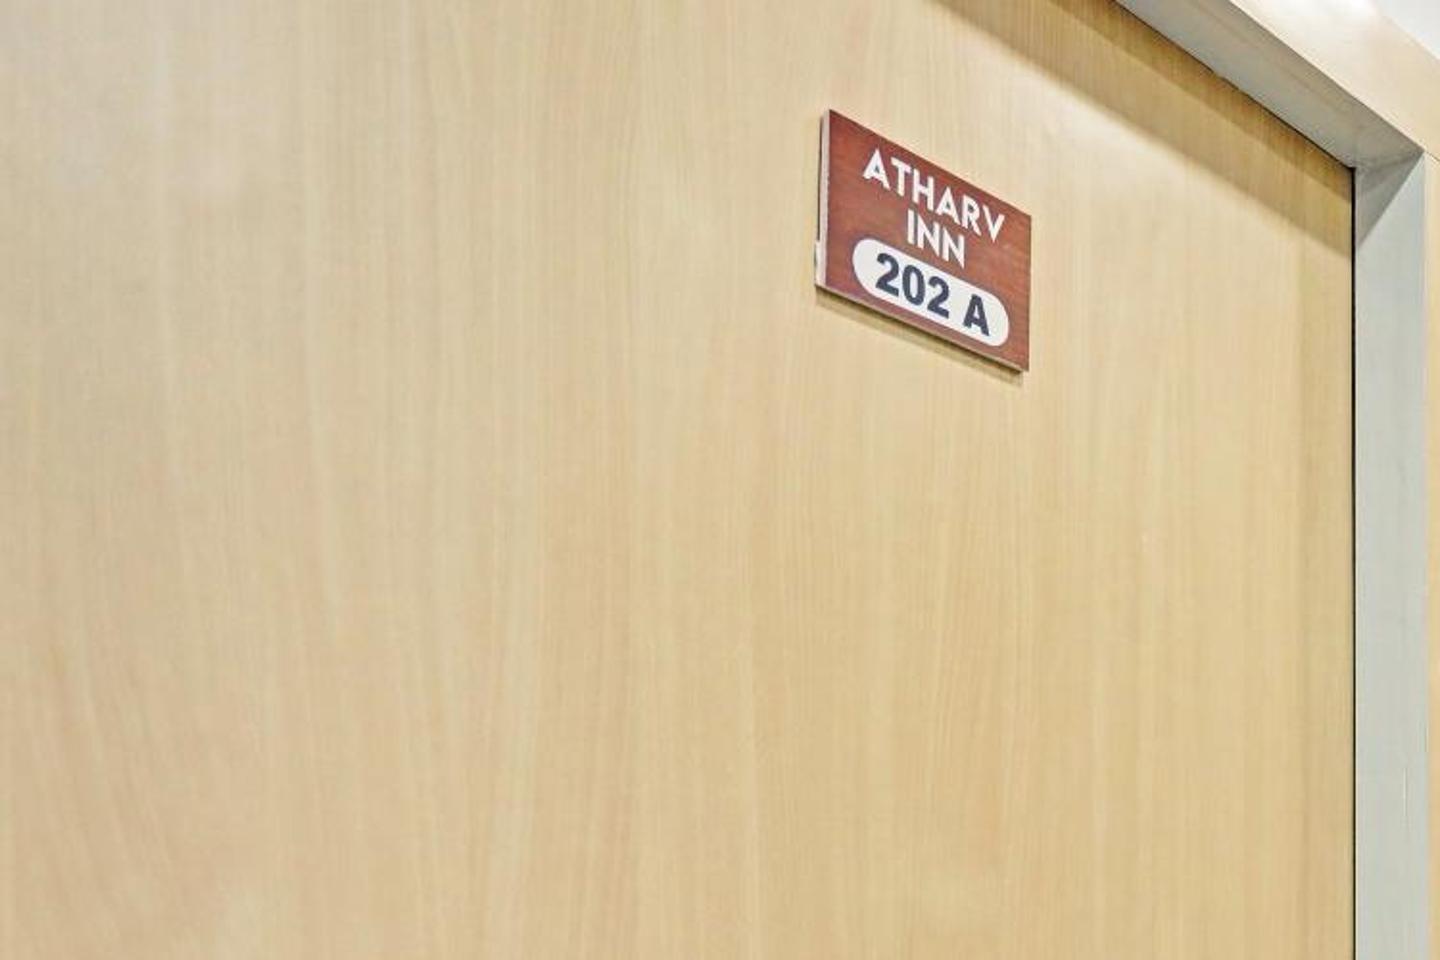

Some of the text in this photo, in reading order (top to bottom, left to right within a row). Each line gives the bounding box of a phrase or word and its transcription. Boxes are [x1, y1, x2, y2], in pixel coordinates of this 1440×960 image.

[863, 149, 1005, 242] ATHARV
[907, 209, 966, 269] INN
[876, 252, 990, 337] 202 A
